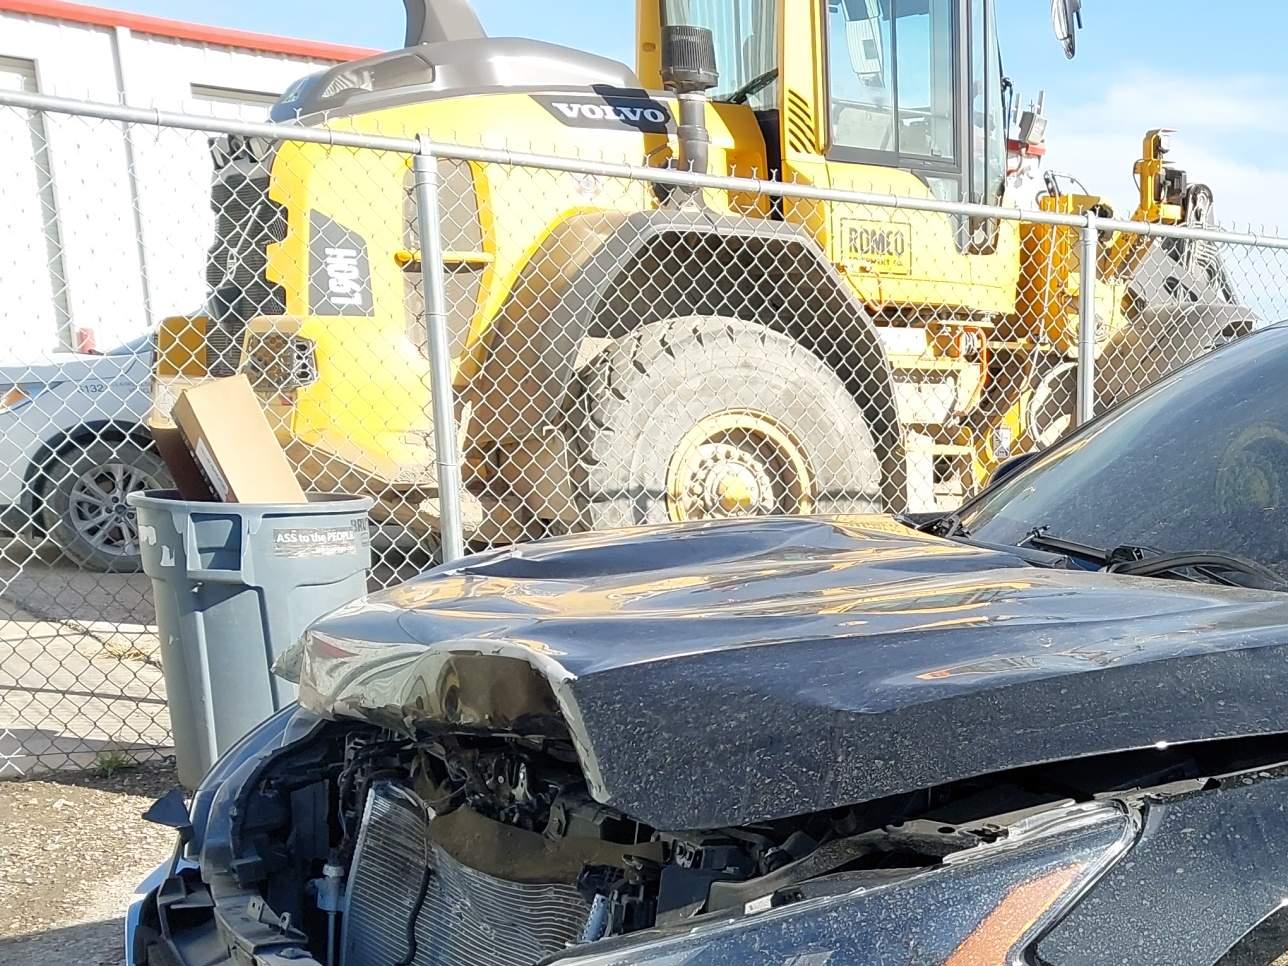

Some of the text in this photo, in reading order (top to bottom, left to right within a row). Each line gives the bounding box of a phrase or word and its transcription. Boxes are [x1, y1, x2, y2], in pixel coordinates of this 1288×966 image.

[551, 102, 665, 123] VOLVO
[849, 227, 904, 256] ROMEO
[298, 533, 310, 543] to
[311, 531, 326, 542] the
